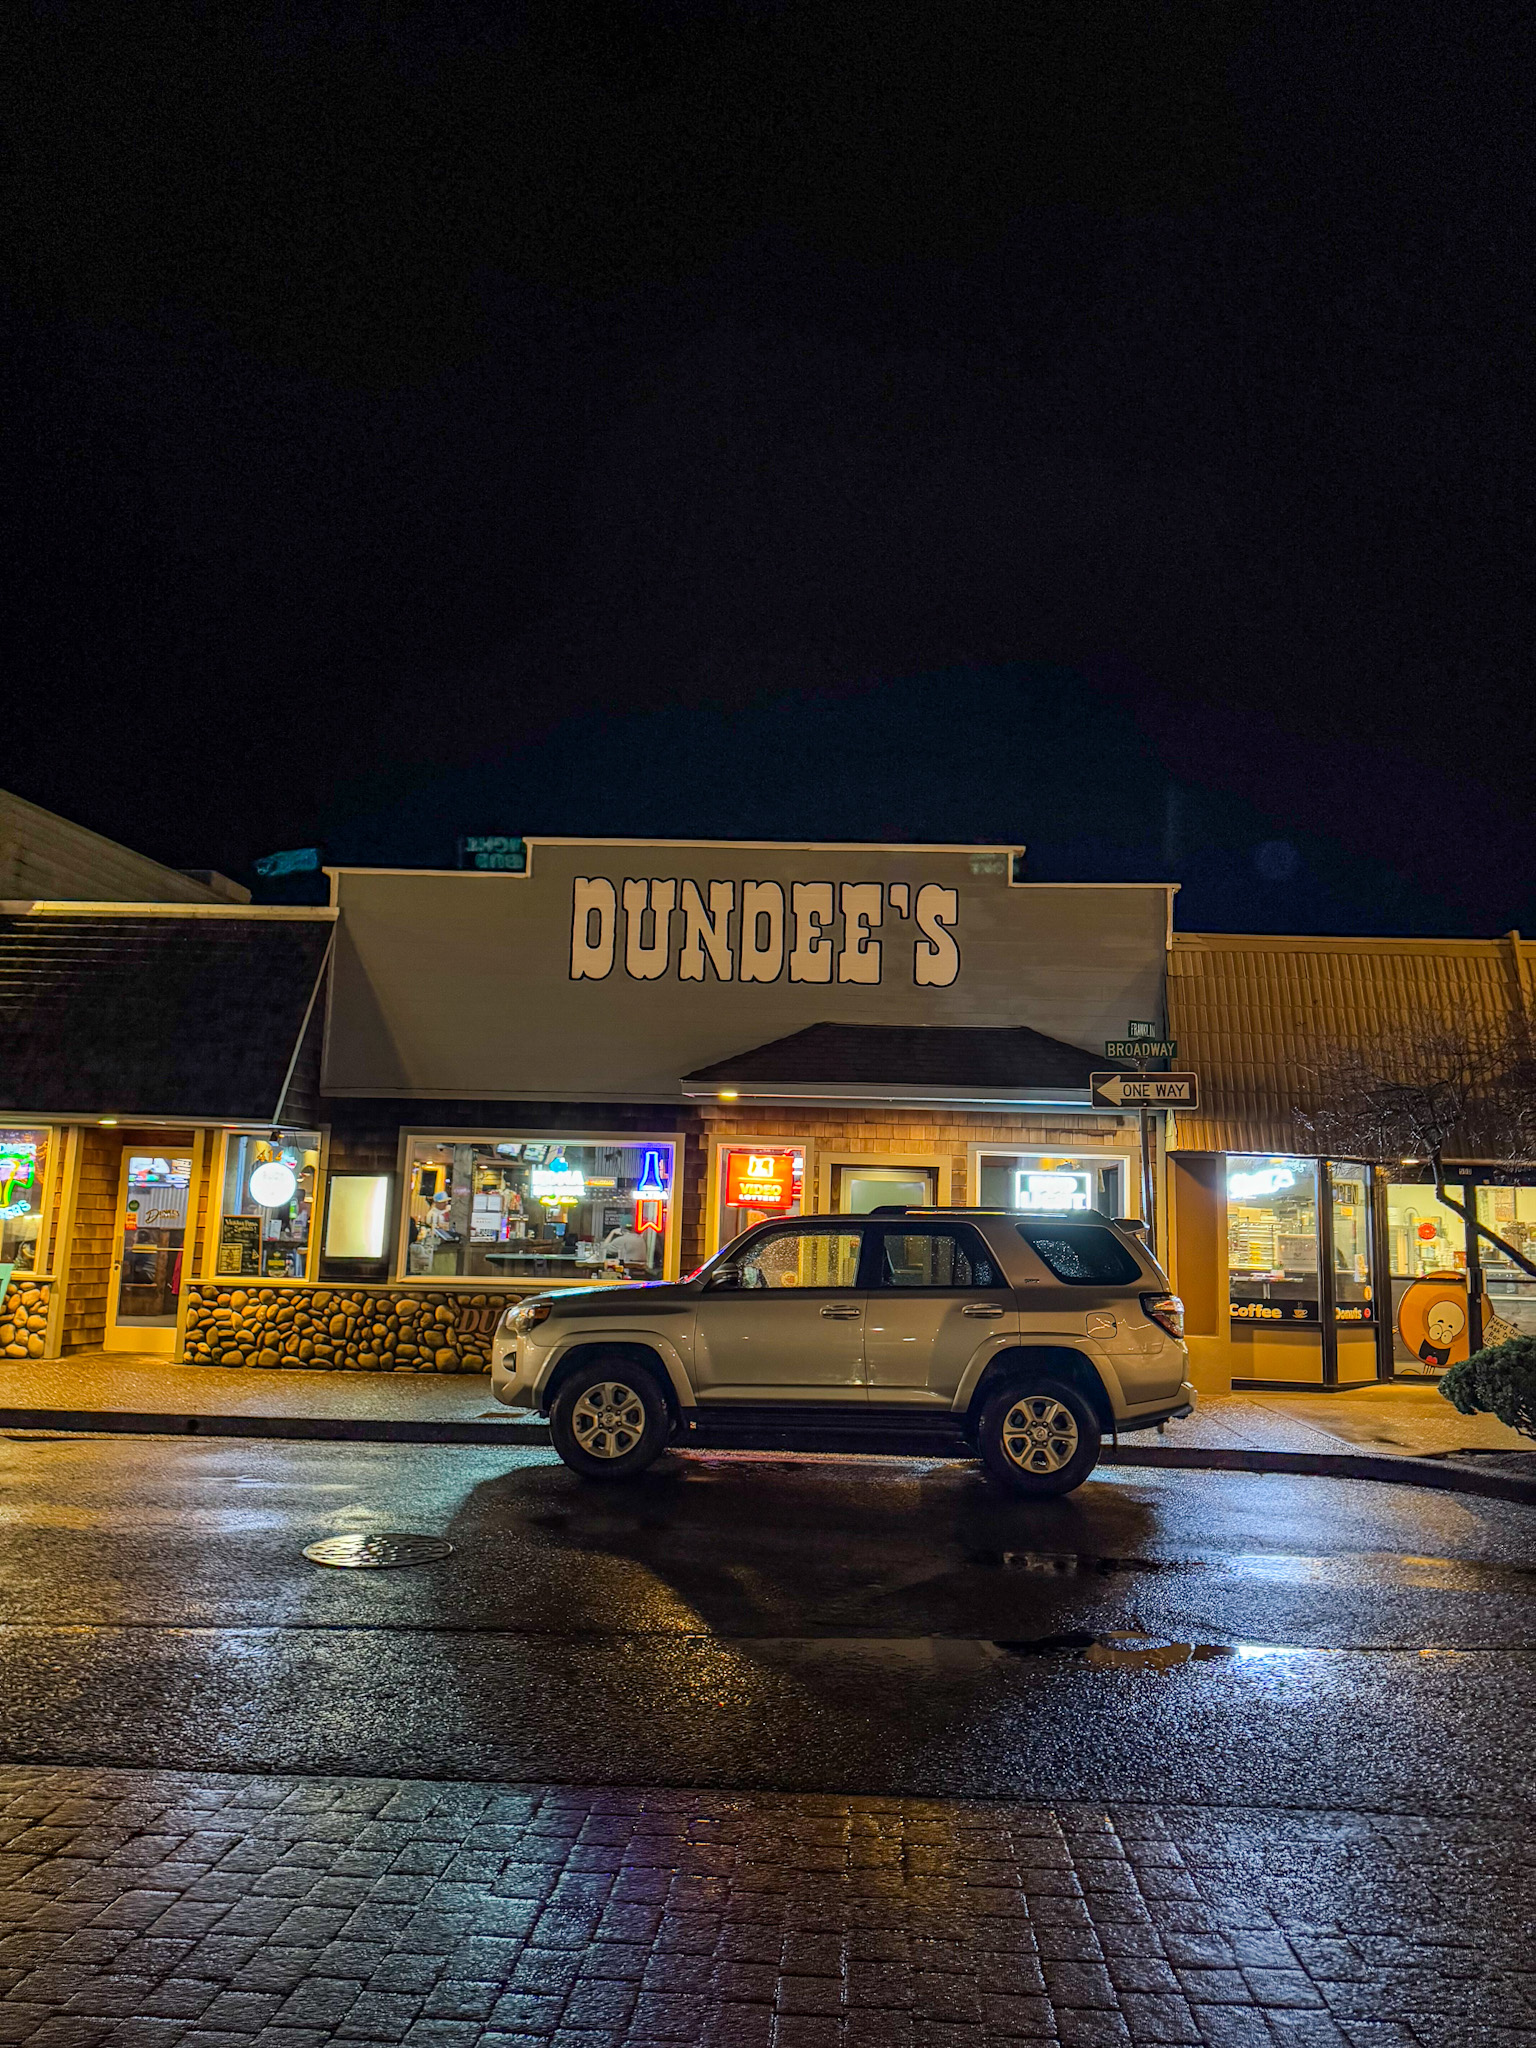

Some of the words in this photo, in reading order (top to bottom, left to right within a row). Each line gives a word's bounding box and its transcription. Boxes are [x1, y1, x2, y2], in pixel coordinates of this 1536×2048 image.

[466, 836, 524, 853] IGHT
[568, 876, 960, 987] DUNDEE'S
[1130, 1022, 1156, 1038] FRANKLIN
[1107, 1043, 1175, 1057] BROADWAY
[1123, 1084, 1150, 1097] ONE
[1156, 1084, 1185, 1097] WAY
[739, 1182, 782, 1196] VIDEO
[1332, 1183, 1359, 1204] OPEN
[738, 1194, 782, 1202] LOTTERY
[1229, 1303, 1283, 1319] Coffee
[1335, 1306, 1362, 1321] Donuts
[456, 1308, 504, 1334] DU
[1490, 1316, 1509, 1331] Need
[1488, 1325, 1501, 1335] Ask
